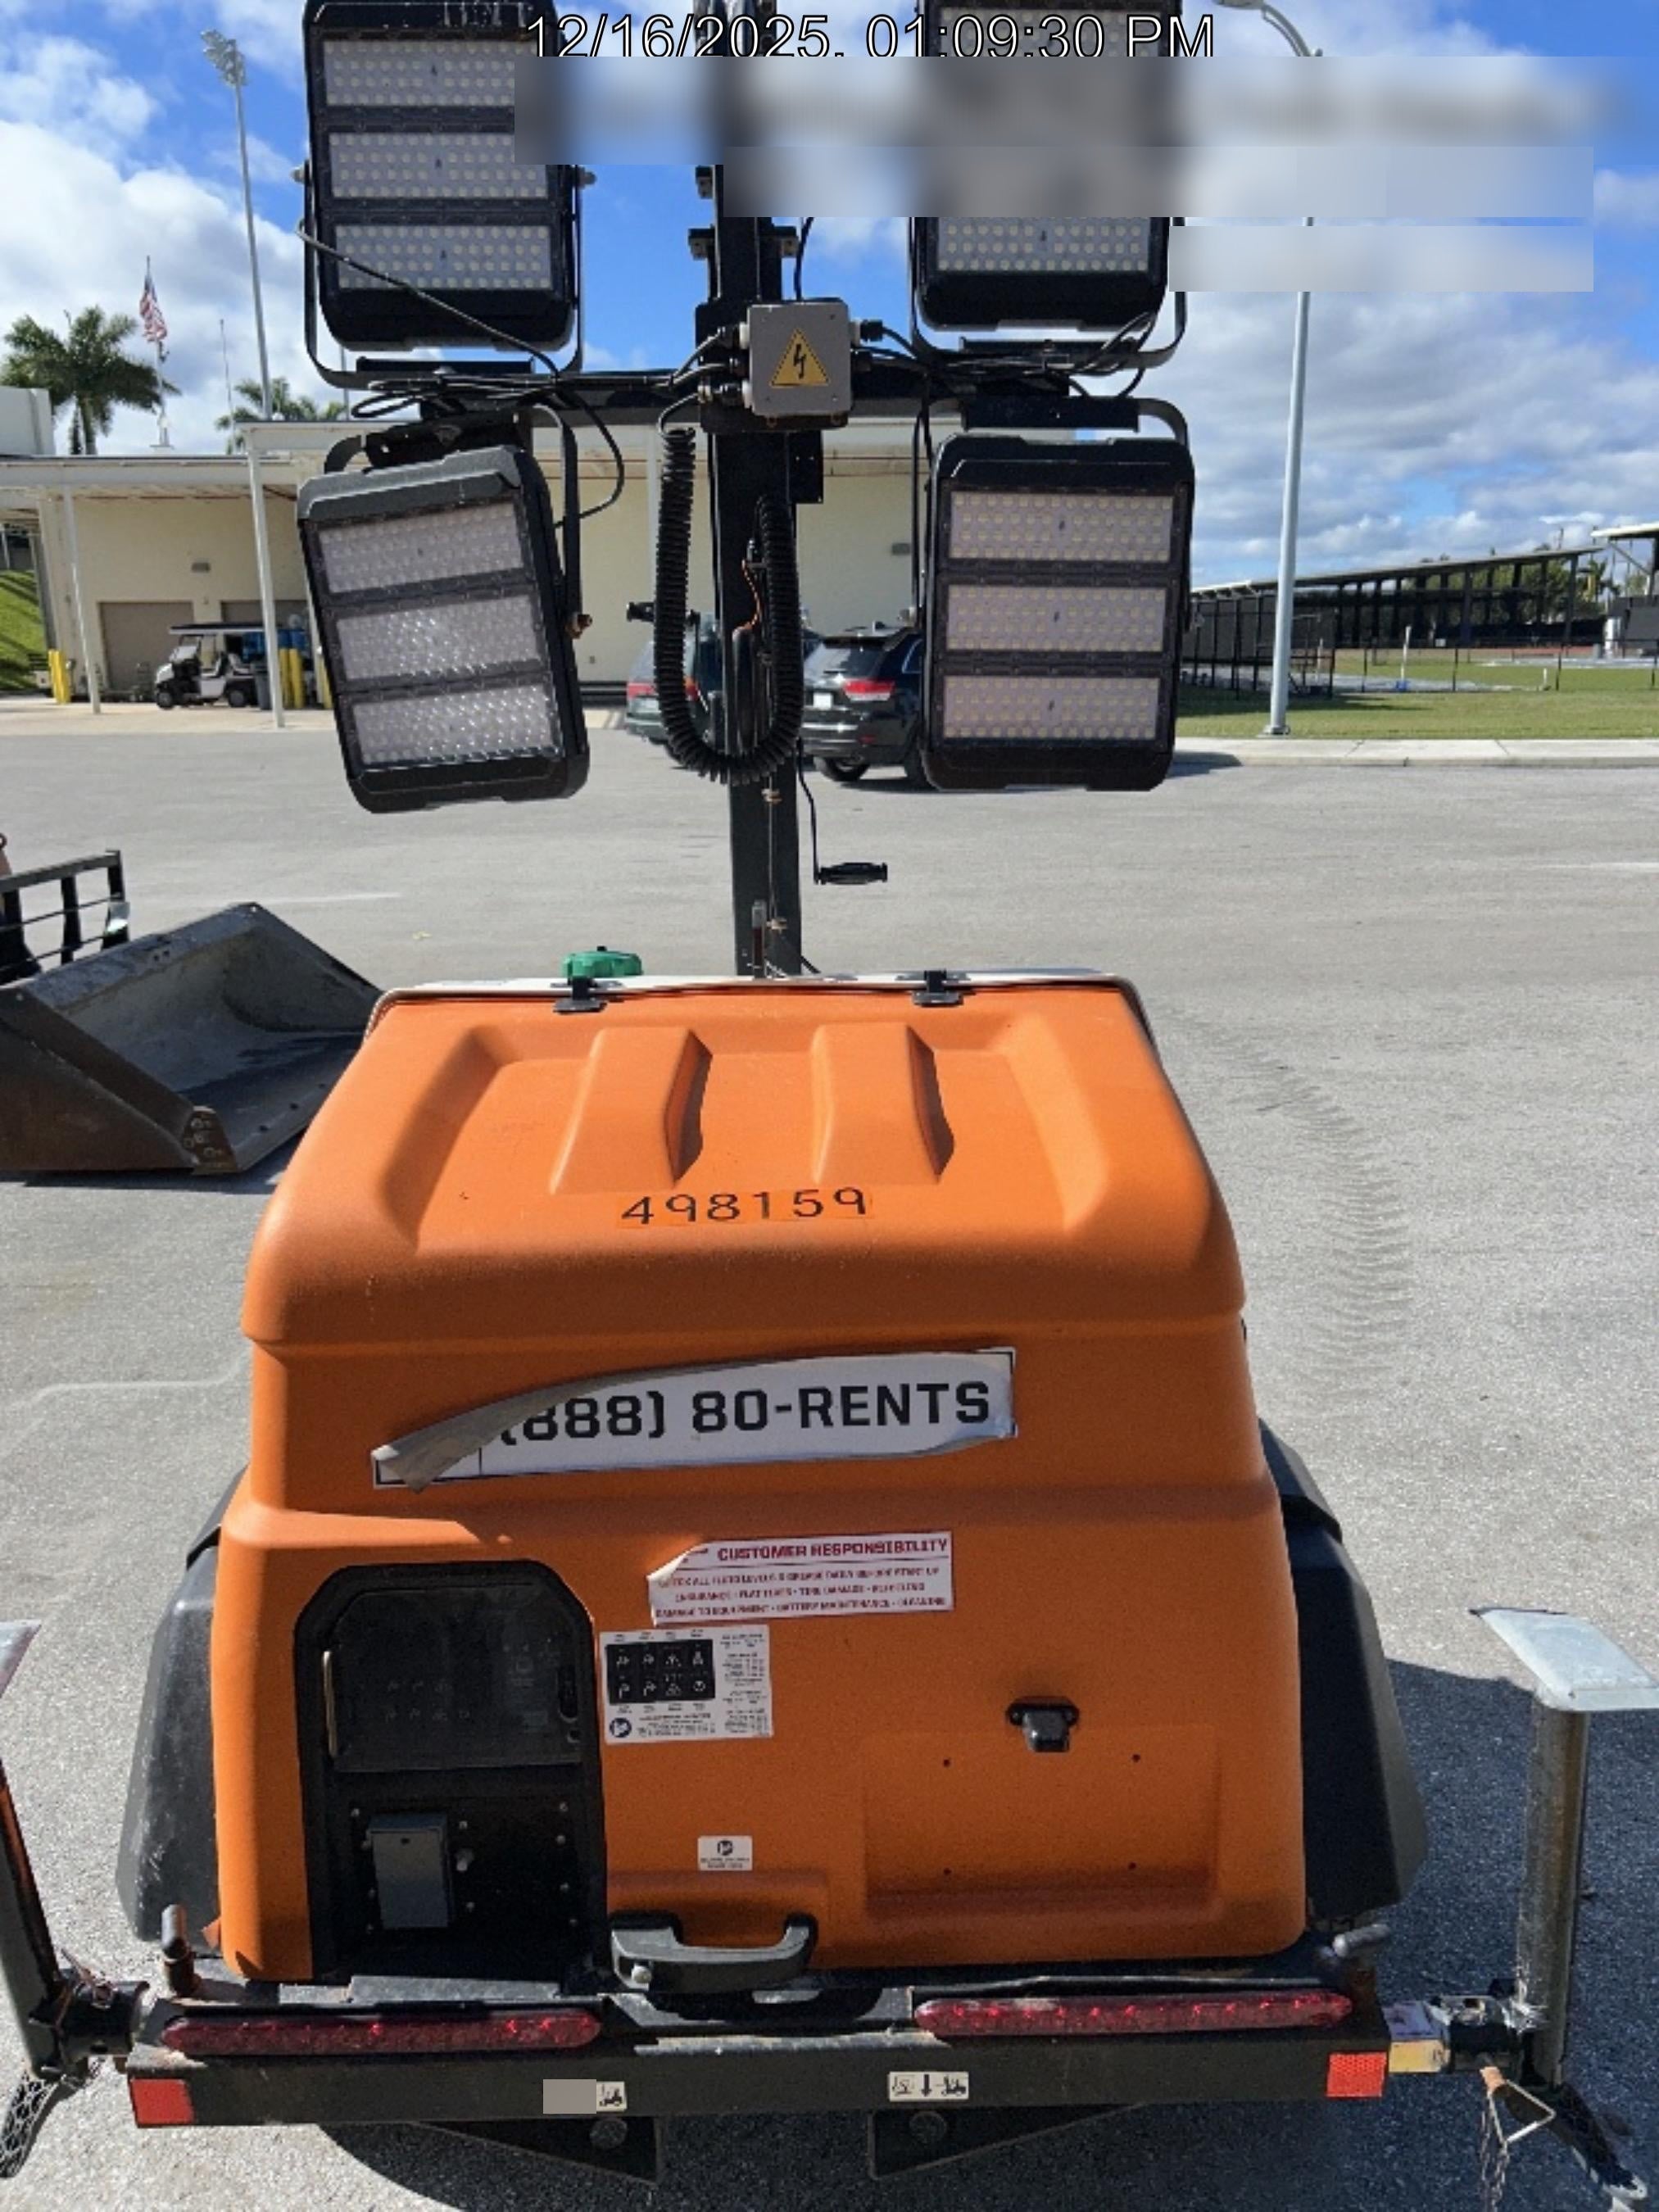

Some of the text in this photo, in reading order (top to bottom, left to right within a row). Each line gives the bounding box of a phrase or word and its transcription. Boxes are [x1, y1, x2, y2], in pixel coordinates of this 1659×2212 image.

[621, 1187, 867, 1225] 498159
[691, 1380, 990, 1435] 80-RENTS
[717, 1543, 808, 1562] CUSTOMER
[811, 1538, 948, 1557] RESPONSIBILITY
